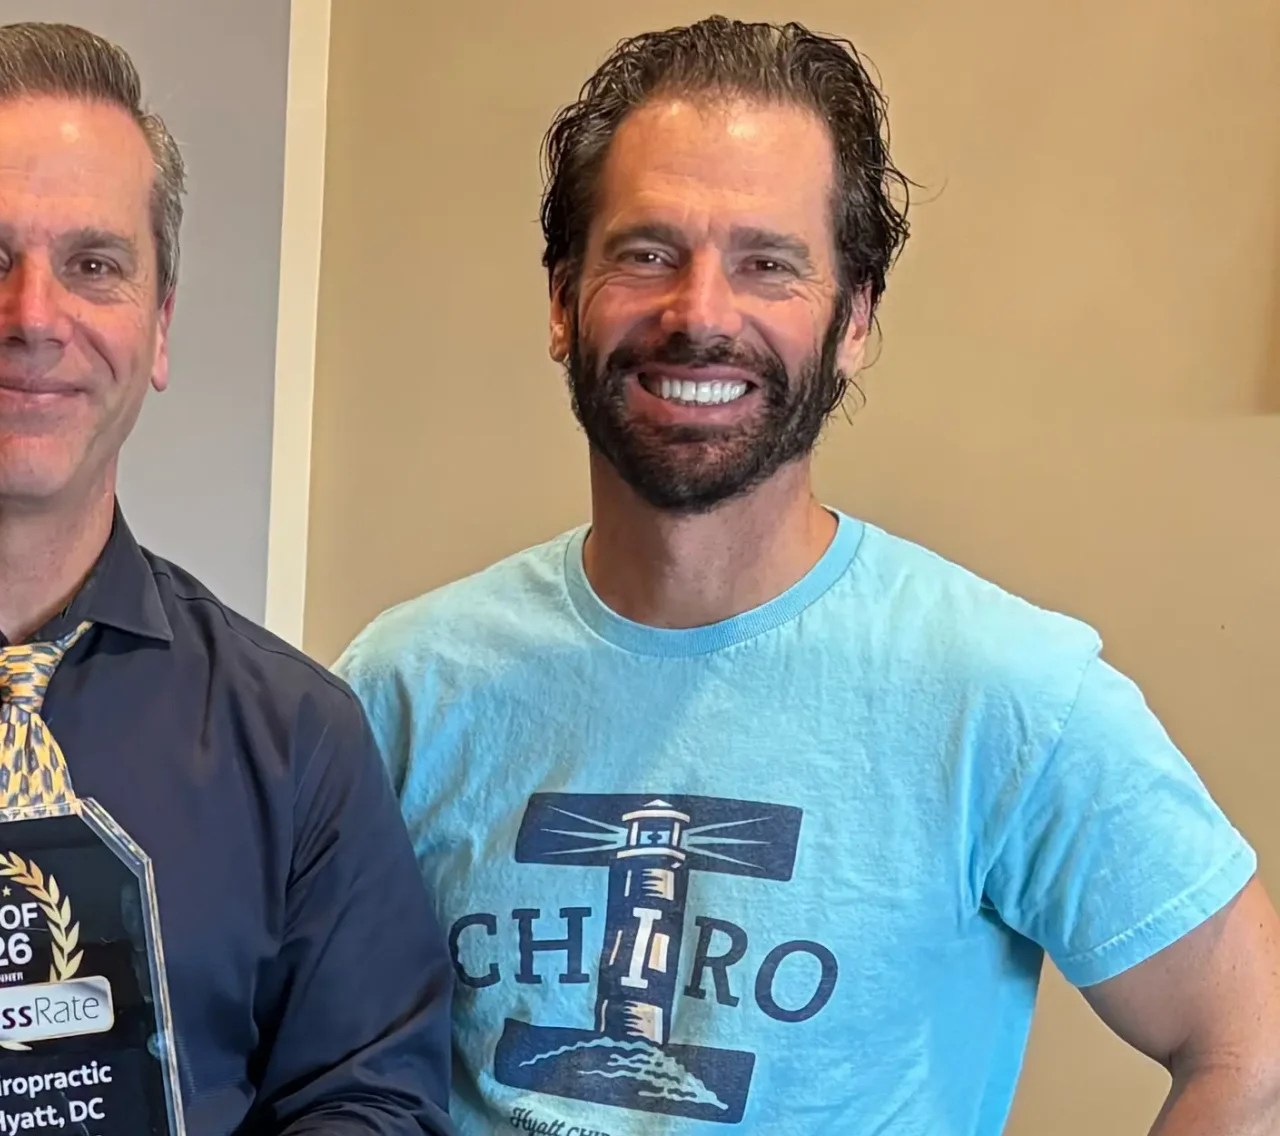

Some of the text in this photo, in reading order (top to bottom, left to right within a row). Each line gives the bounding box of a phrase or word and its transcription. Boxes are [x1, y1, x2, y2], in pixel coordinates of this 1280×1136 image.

[0, 902, 39, 929] OF
[448, 906, 839, 1023] CHIRO
[69, 1097, 106, 1124] DC
